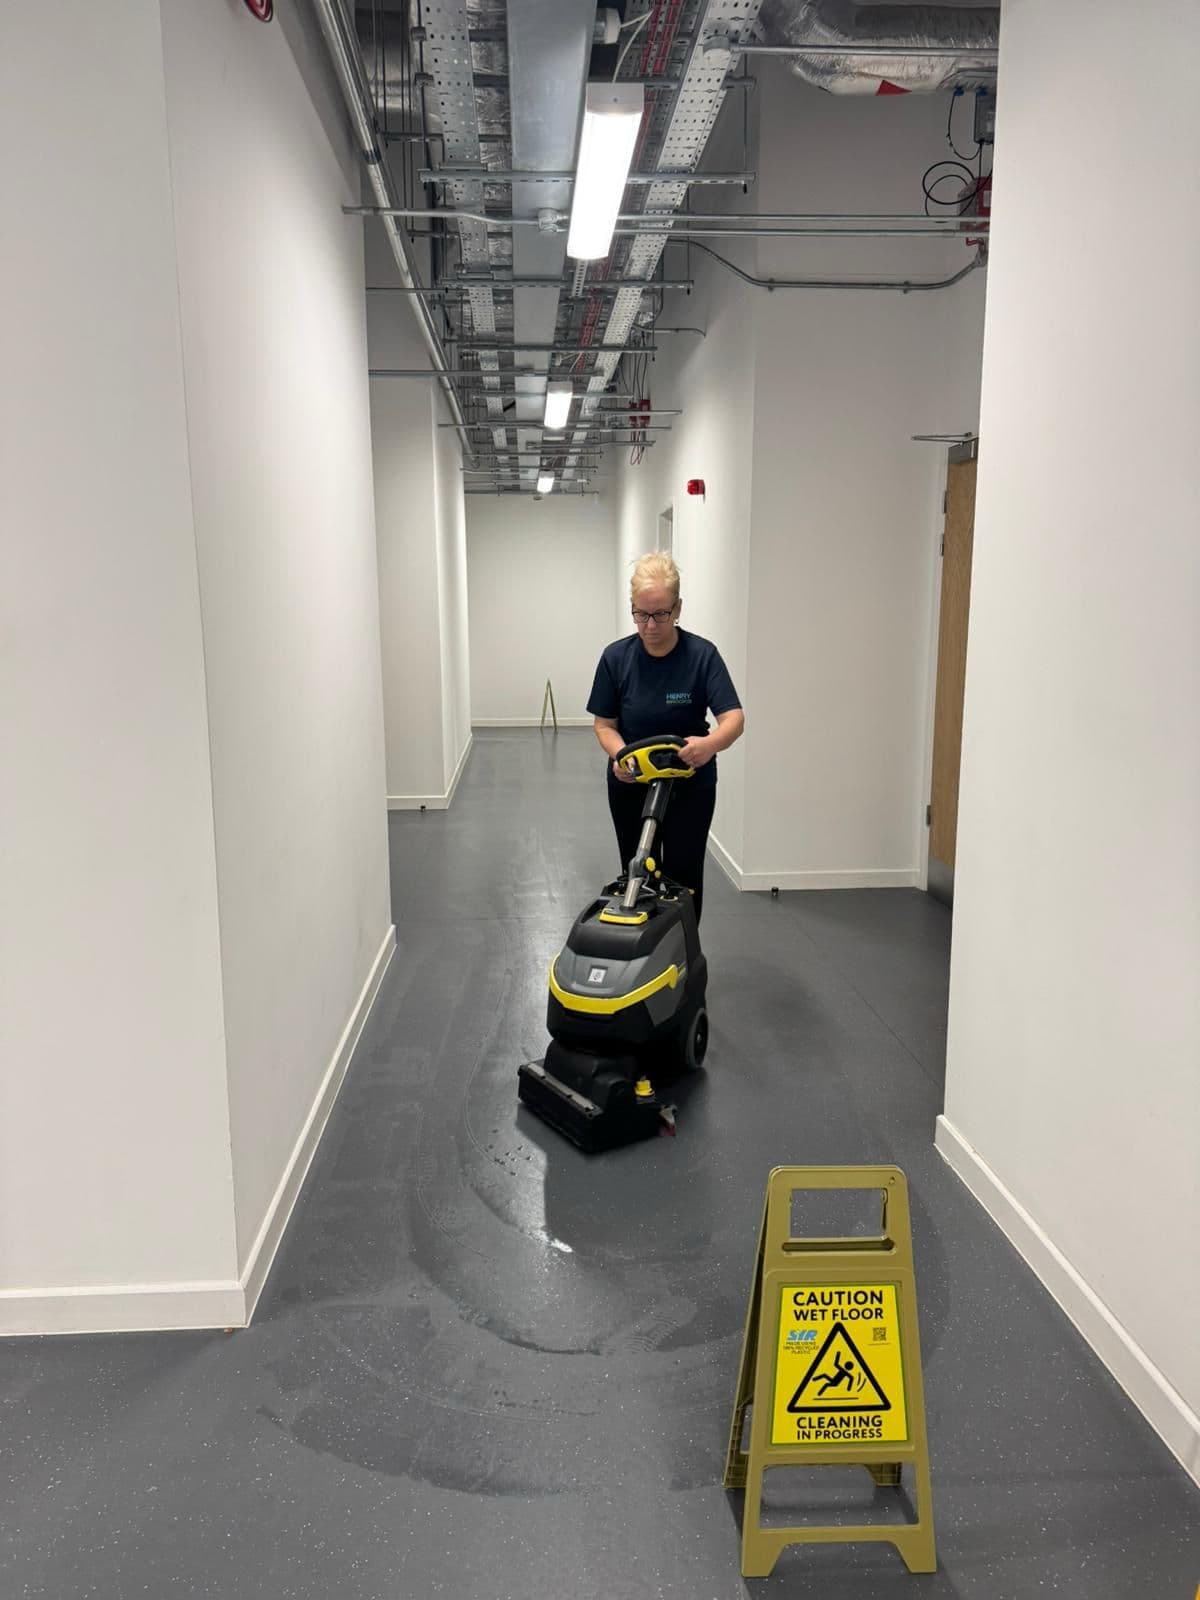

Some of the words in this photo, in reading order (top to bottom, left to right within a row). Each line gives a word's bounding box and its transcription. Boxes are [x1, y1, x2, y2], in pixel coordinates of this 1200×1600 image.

[793, 1290, 883, 1306] CAUTION
[793, 1309, 828, 1321] WET
[832, 1308, 884, 1320] FLOOR
[796, 1415, 883, 1429] CLEANING
[797, 1430, 811, 1440] IN
[815, 1428, 883, 1439] PROGRESS
